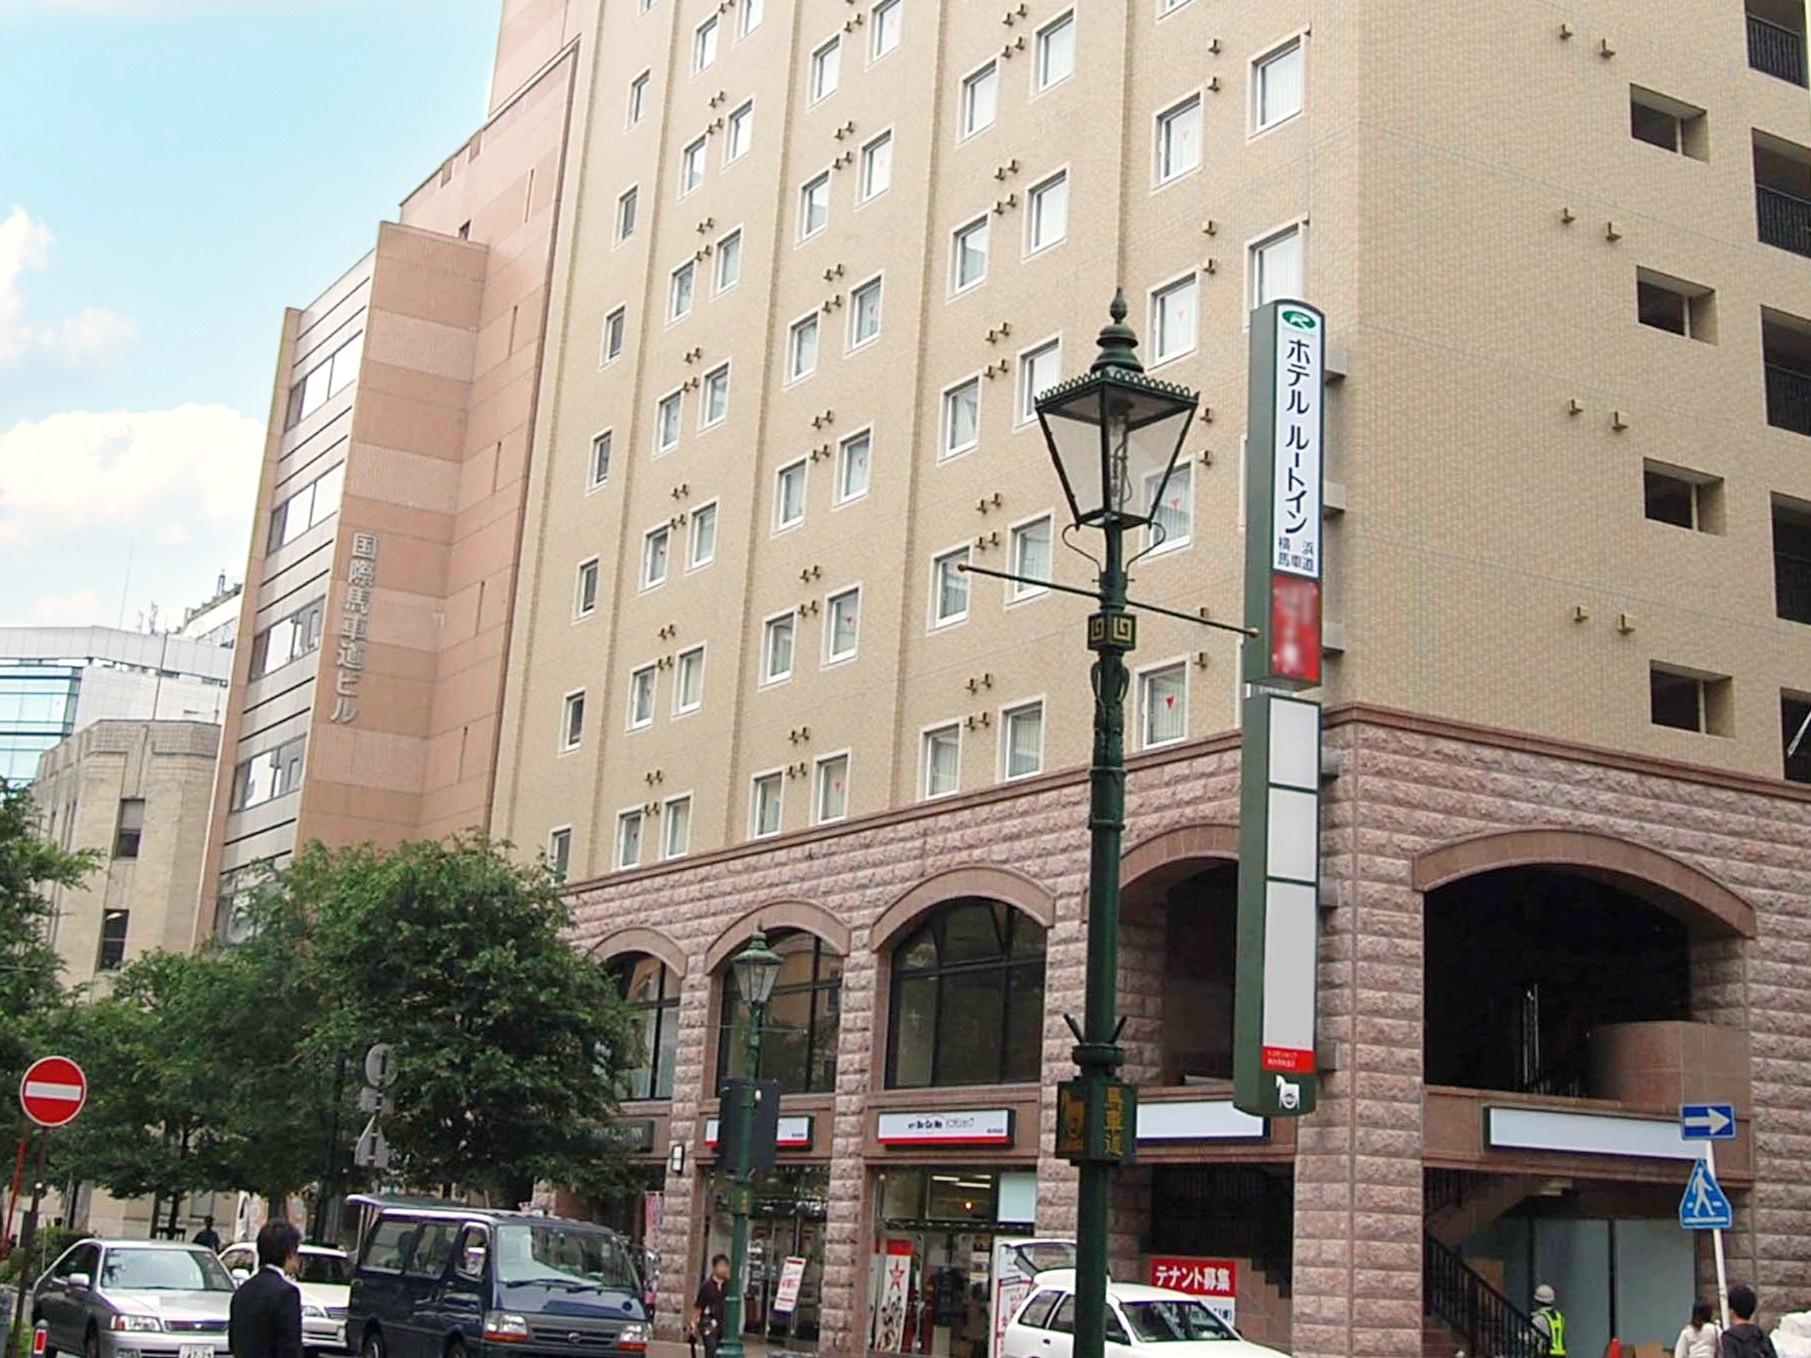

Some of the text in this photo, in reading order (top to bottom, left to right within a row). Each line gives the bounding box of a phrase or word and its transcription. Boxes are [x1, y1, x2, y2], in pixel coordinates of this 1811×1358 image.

[1156, 1265, 1230, 1292] テナント募集
